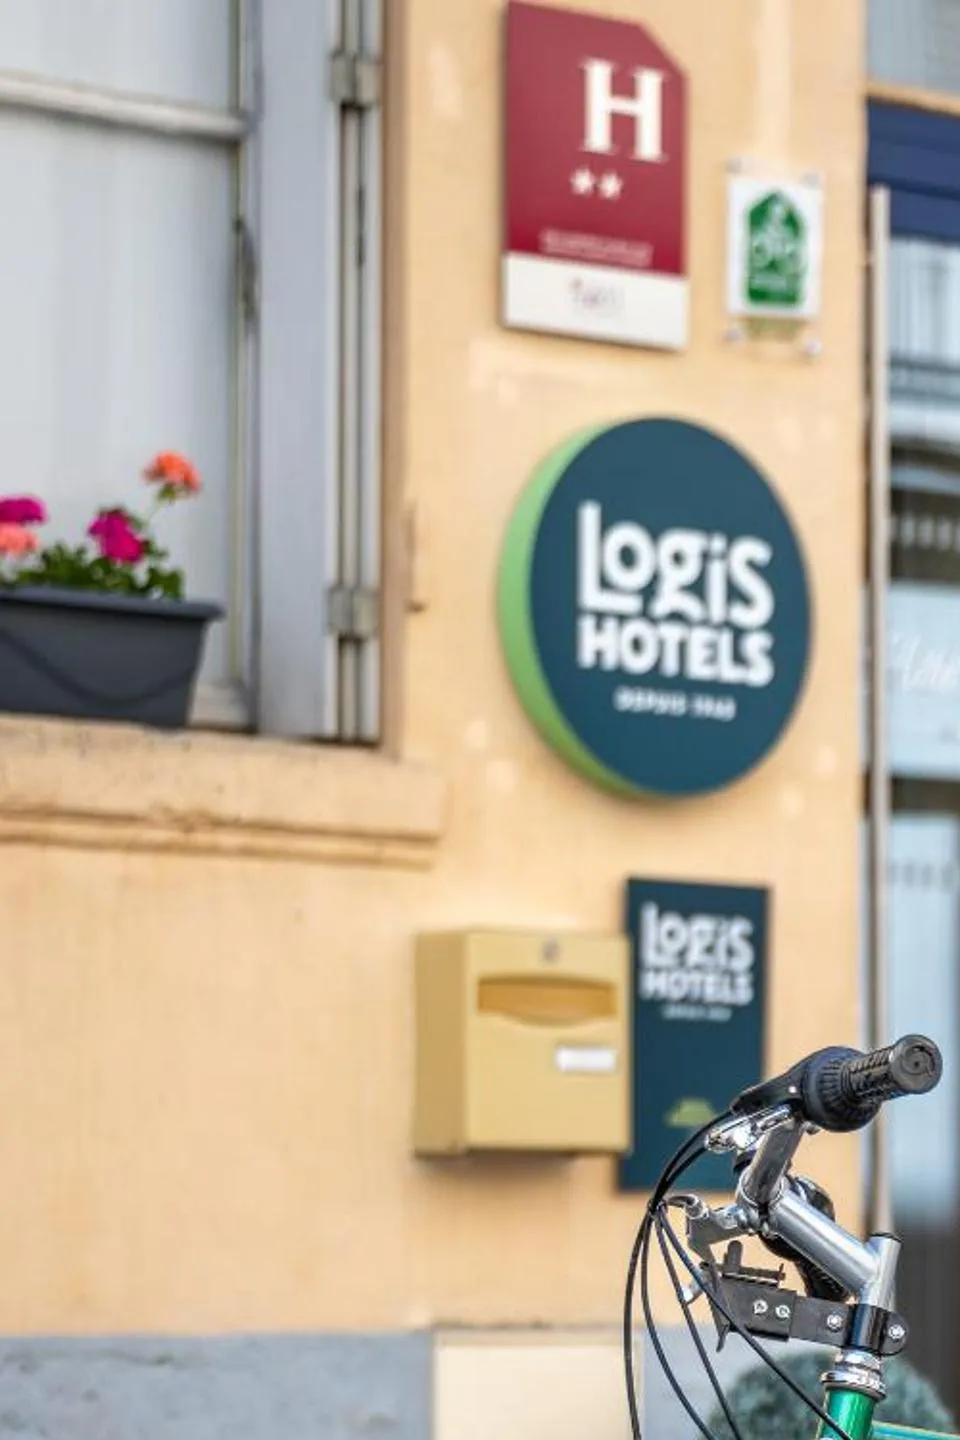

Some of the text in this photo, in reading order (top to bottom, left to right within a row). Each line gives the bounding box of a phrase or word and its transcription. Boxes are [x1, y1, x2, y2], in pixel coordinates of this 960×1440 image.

[581, 56, 667, 163] H
[576, 613, 775, 687] HOTELS
[640, 970, 755, 1006] HOTELS
